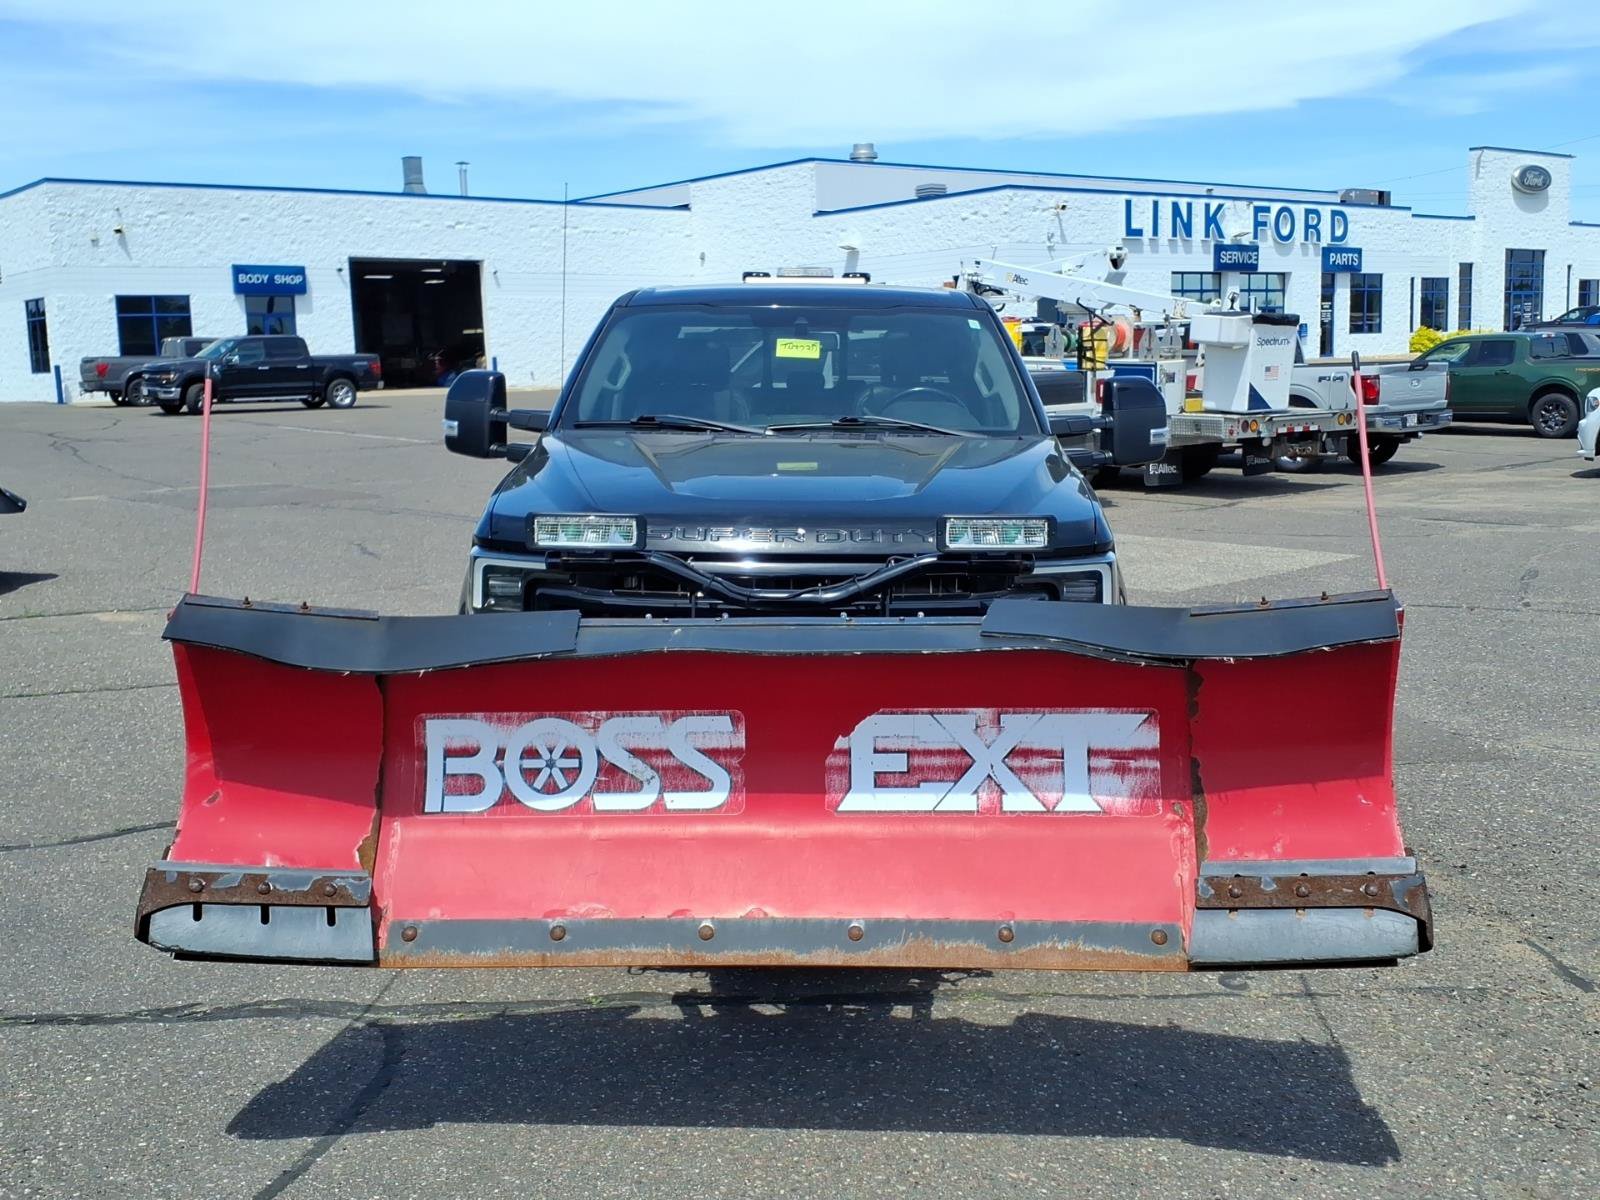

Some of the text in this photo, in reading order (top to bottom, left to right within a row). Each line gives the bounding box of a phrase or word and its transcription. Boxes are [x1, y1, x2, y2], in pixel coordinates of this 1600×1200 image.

[1125, 199, 1349, 244] LINK FORD
[1219, 250, 1258, 265] SERVICE
[1329, 252, 1359, 266] PARTS
[238, 273, 304, 285] BODY SHOP
[1256, 336, 1289, 348] Spectrum
[1158, 463, 1177, 474] Altec
[648, 526, 937, 543] SUPER DUTY
[424, 712, 1151, 814] BOSS EXT
